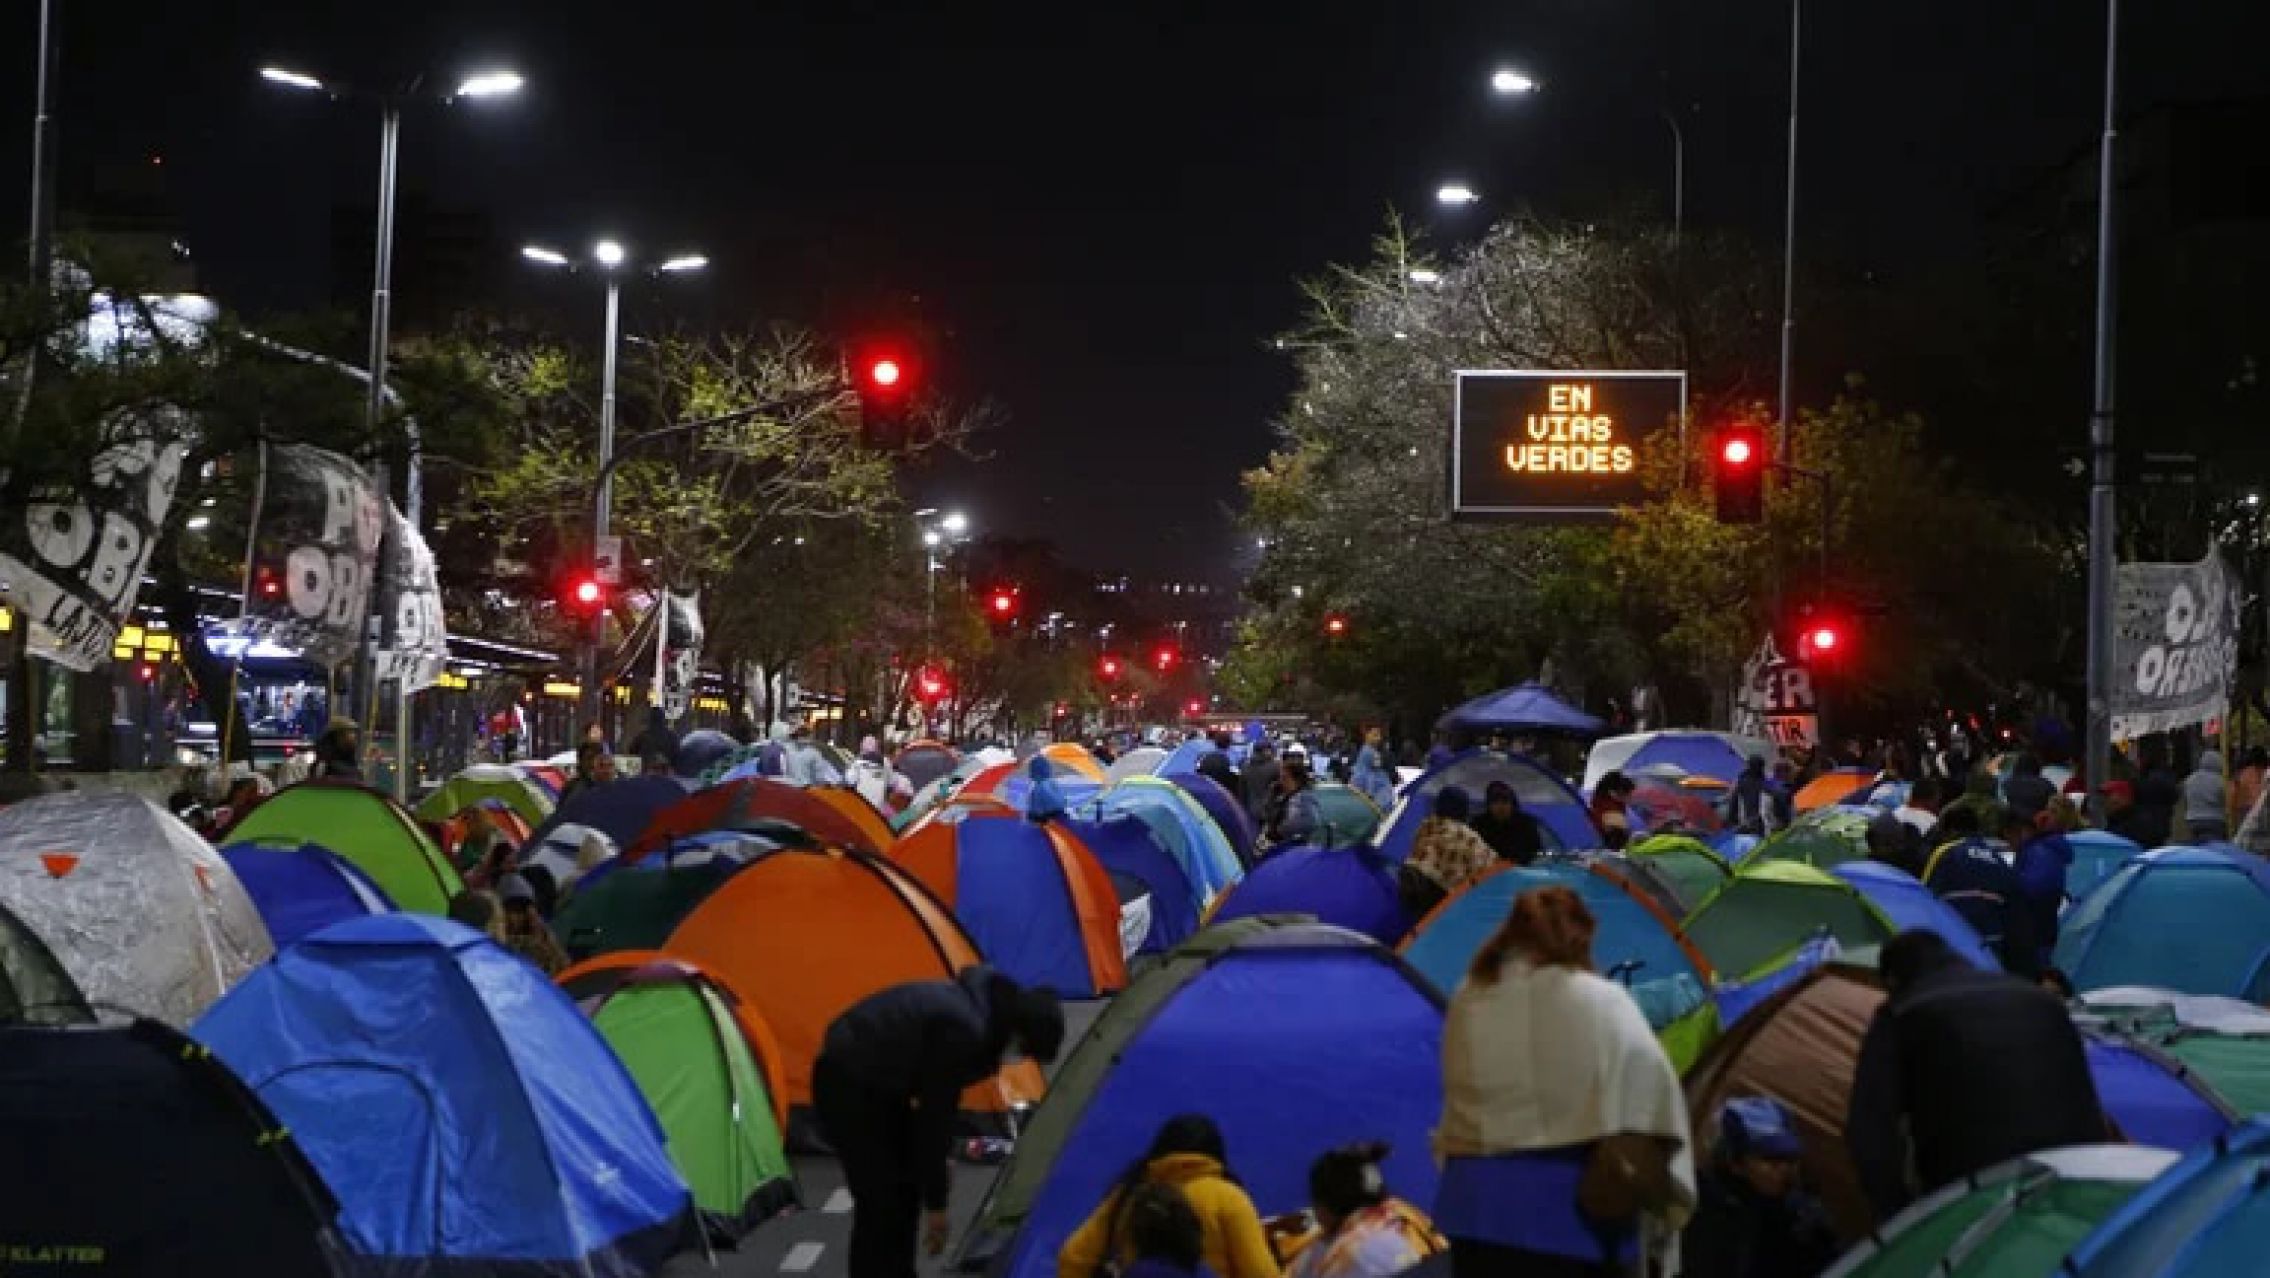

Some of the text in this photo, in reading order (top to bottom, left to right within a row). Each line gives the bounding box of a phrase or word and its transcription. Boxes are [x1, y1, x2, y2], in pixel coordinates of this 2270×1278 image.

[1549, 384, 1592, 412] EN
[1527, 414, 1612, 441] VIAS
[1506, 444, 1633, 472] VERDES
[11, 1246, 104, 1263] KLATTER
